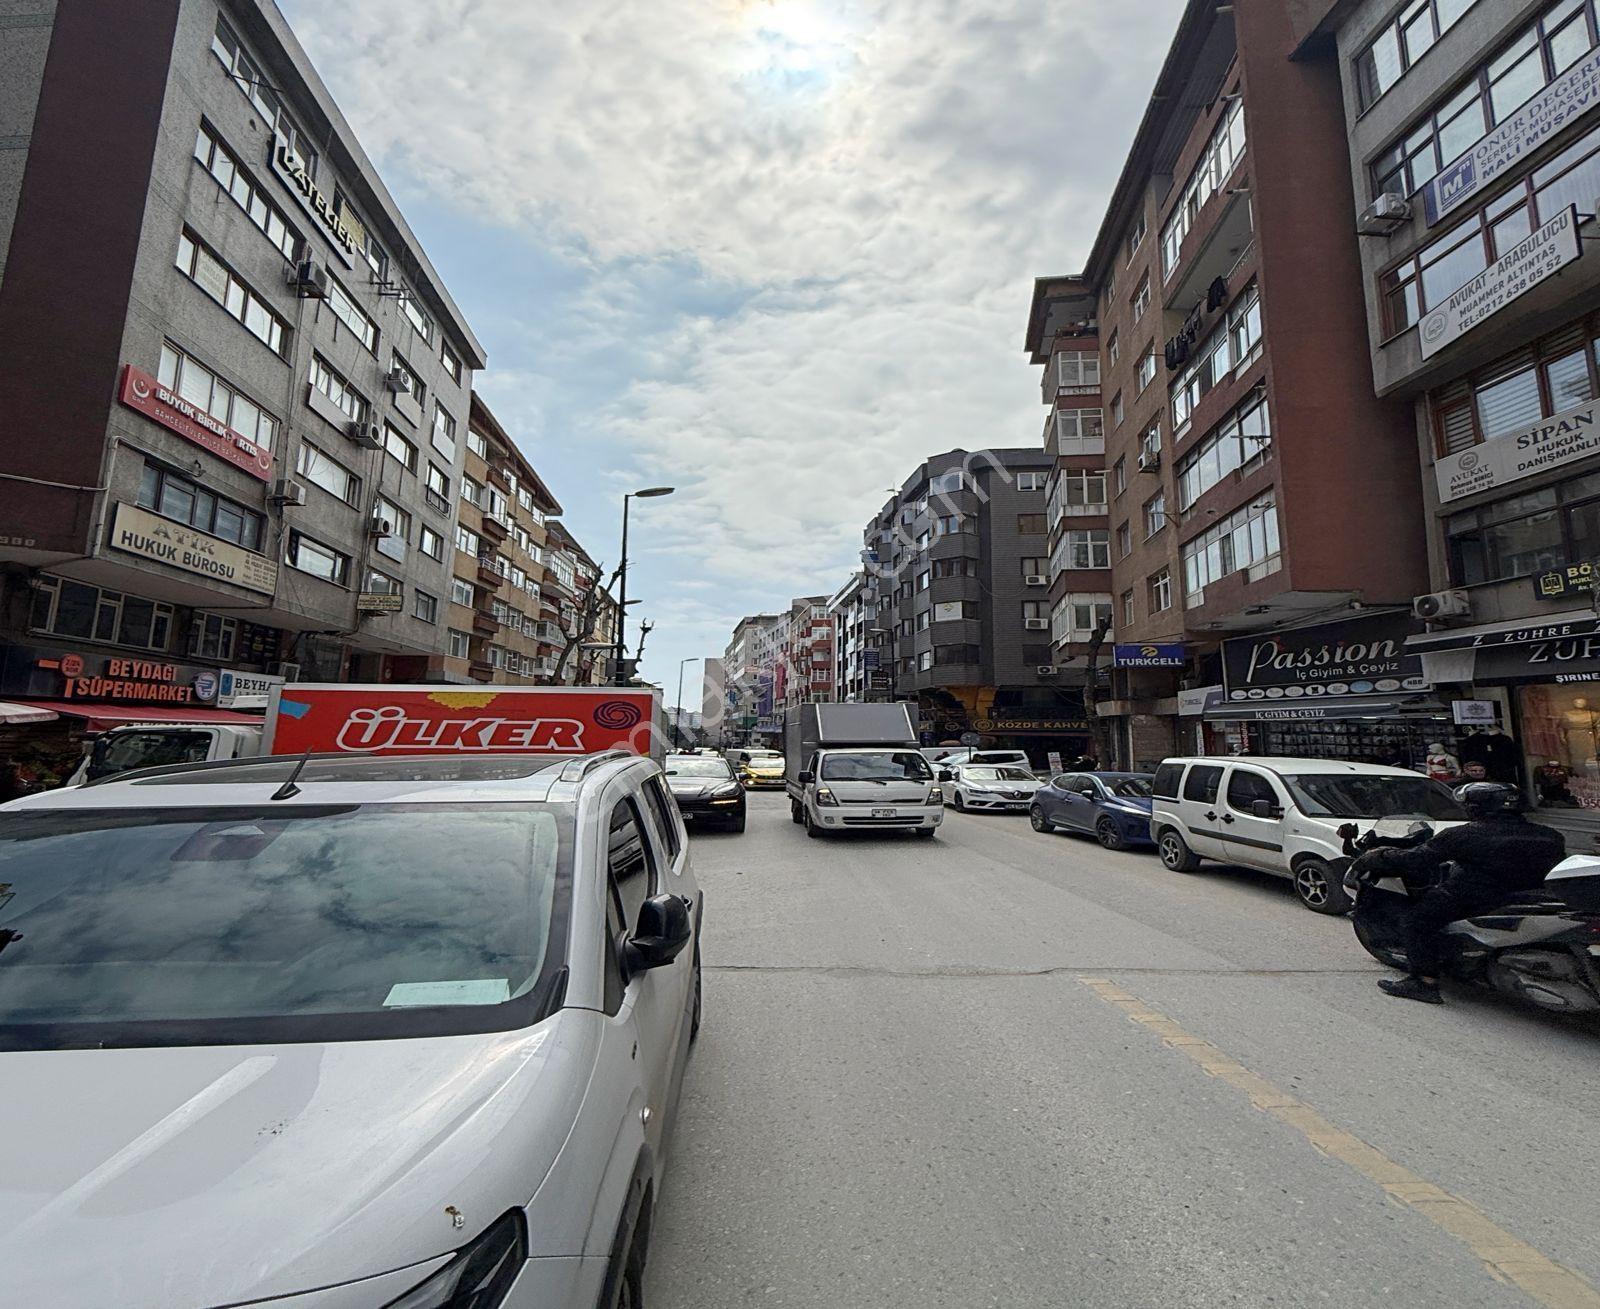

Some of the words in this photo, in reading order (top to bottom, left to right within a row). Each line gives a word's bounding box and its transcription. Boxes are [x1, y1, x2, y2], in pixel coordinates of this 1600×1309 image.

[1476, 117, 1525, 160] ONUR
[1480, 129, 1527, 168] SERBEST
[1449, 273, 1487, 312] AVUKAT
[1498, 212, 1568, 276] ARABULUCU
[1458, 294, 1505, 332] TEL:0212
[1506, 279, 1528, 300] 638
[1529, 269, 1544, 284] 05
[1546, 255, 1563, 273] 52
[1459, 280, 1505, 318] MUAMMER
[157, 388, 195, 420] BÜYÜK
[1516, 409, 1594, 450] SİPAN
[1536, 431, 1585, 455] HUKUK
[1517, 436, 1600, 471] DANIŞMANLI
[1450, 463, 1490, 484] AVUKAT
[121, 530, 177, 561] HUKUK
[183, 552, 235, 579] BÜROSU
[1566, 563, 1592, 578] BÖ
[109, 659, 178, 682] BEYDAĞI
[1118, 657, 1183, 666] TURKCELL
[1246, 638, 1398, 682] Passion
[1309, 665, 1343, 679] Giyim
[1347, 664, 1355, 675] &
[1359, 660, 1399, 676] Çeyiz
[77, 677, 194, 702] SÜPERMARKET
[336, 706, 585, 751] ÜLKER
[998, 719, 1039, 729] KÖZDE
[1044, 721, 1089, 729] KAHVE
